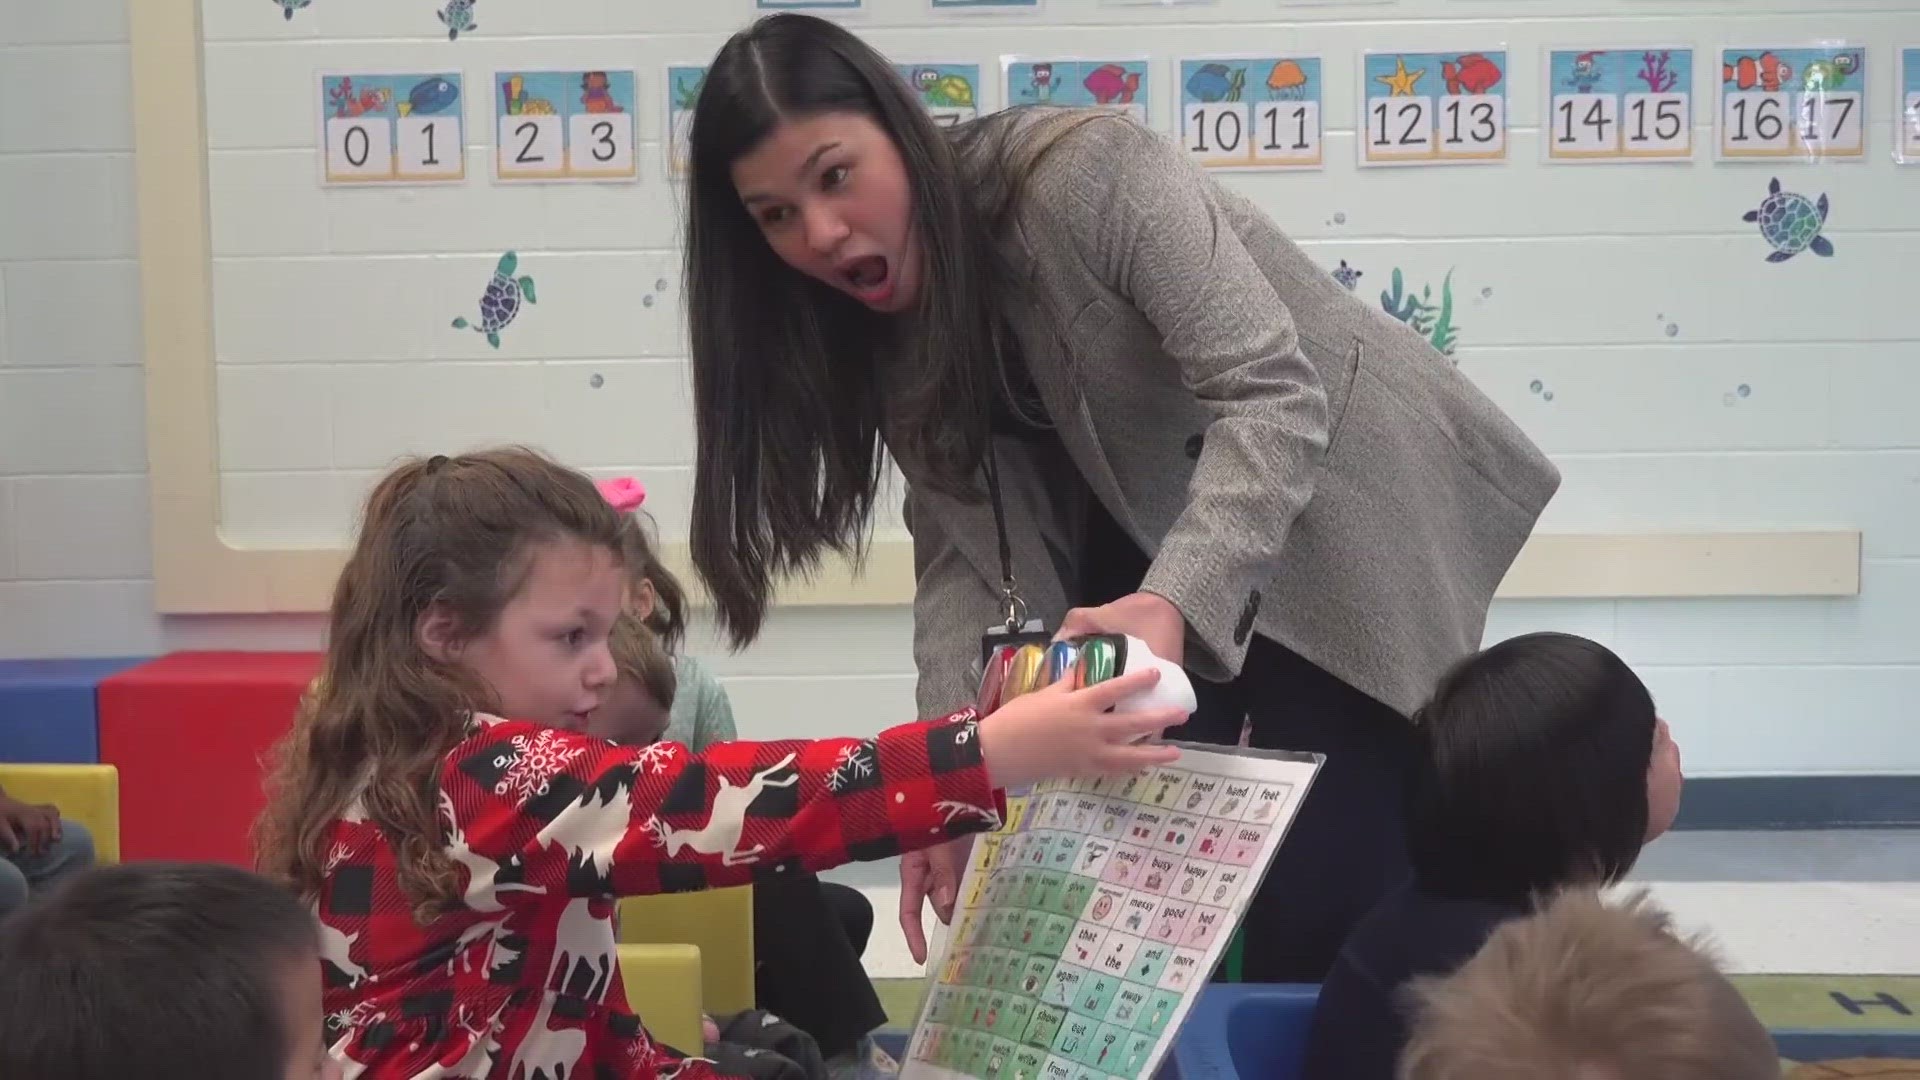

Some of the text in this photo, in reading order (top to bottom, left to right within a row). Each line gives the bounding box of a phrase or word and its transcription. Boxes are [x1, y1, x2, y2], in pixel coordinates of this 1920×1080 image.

[1373, 101, 1497, 145] 12 13
[1558, 99, 1682, 142] 14 15
[1730, 97, 1855, 141] 16 17
[1191, 107, 1310, 152] 10 11
[344, 123, 440, 168] 0 1
[514, 121, 617, 163] 2 3
[1192, 779, 1215, 792] head
[1226, 784, 1249, 798] hand
[1260, 787, 1281, 800] feet
[1209, 824, 1223, 838] big
[1238, 829, 1261, 842] little
[1116, 850, 1142, 864] ready
[1152, 857, 1174, 872] busy
[1184, 863, 1208, 879] happy
[1219, 872, 1237, 884] sad
[1129, 898, 1155, 912] messy
[1162, 906, 1187, 919] good
[1198, 911, 1217, 925] bad
[1078, 928, 1098, 943] that
[1104, 955, 1122, 970] the
[1145, 949, 1163, 961] and
[1173, 954, 1195, 967] more
[1056, 970, 1080, 984] again
[1121, 990, 1144, 1005] away
[1828, 991, 1913, 1016] H
[1037, 1010, 1058, 1025] show
[1047, 1060, 1070, 1078] front
